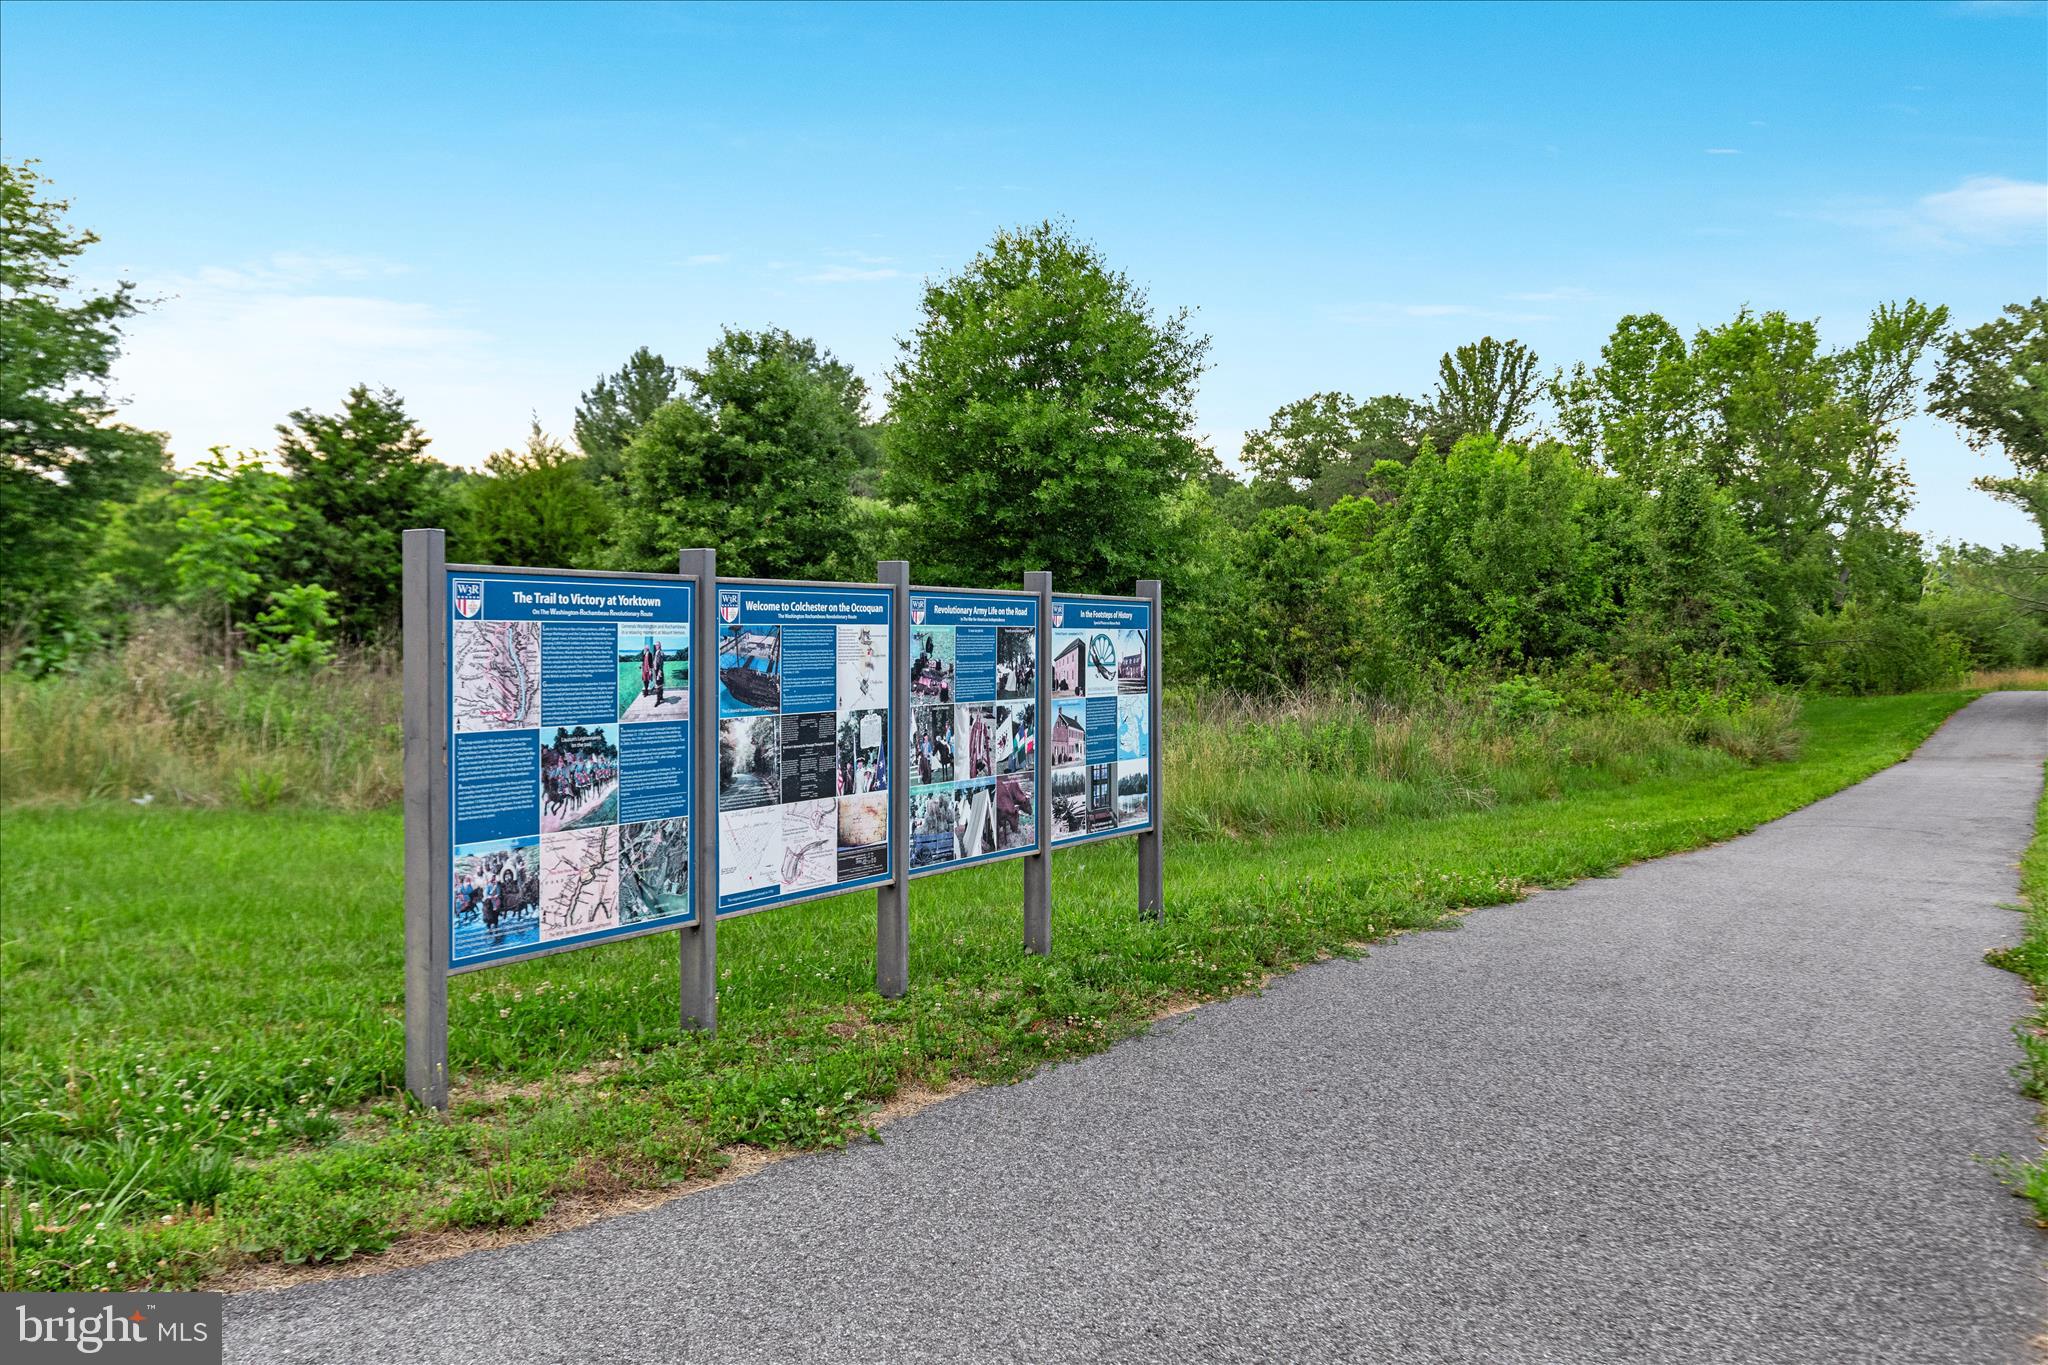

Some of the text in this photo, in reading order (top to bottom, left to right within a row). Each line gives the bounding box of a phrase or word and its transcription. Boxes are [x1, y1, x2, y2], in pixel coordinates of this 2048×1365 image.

[457, 584, 480, 596] W3R
[512, 591, 661, 608] The Trail to Victory at Yorktown
[609, 609, 640, 618] Revolutionary
[745, 600, 884, 615] Welcome to Colchester on the Occoquan
[934, 604, 972, 616] Revolutionary
[973, 606, 987, 616] Army
[987, 606, 998, 615] Life
[1005, 607, 1015, 616] the
[1015, 607, 1028, 616] Road
[1080, 610, 1085, 618] In
[1093, 610, 1112, 620] Footsteps
[1118, 612, 1133, 620] History
